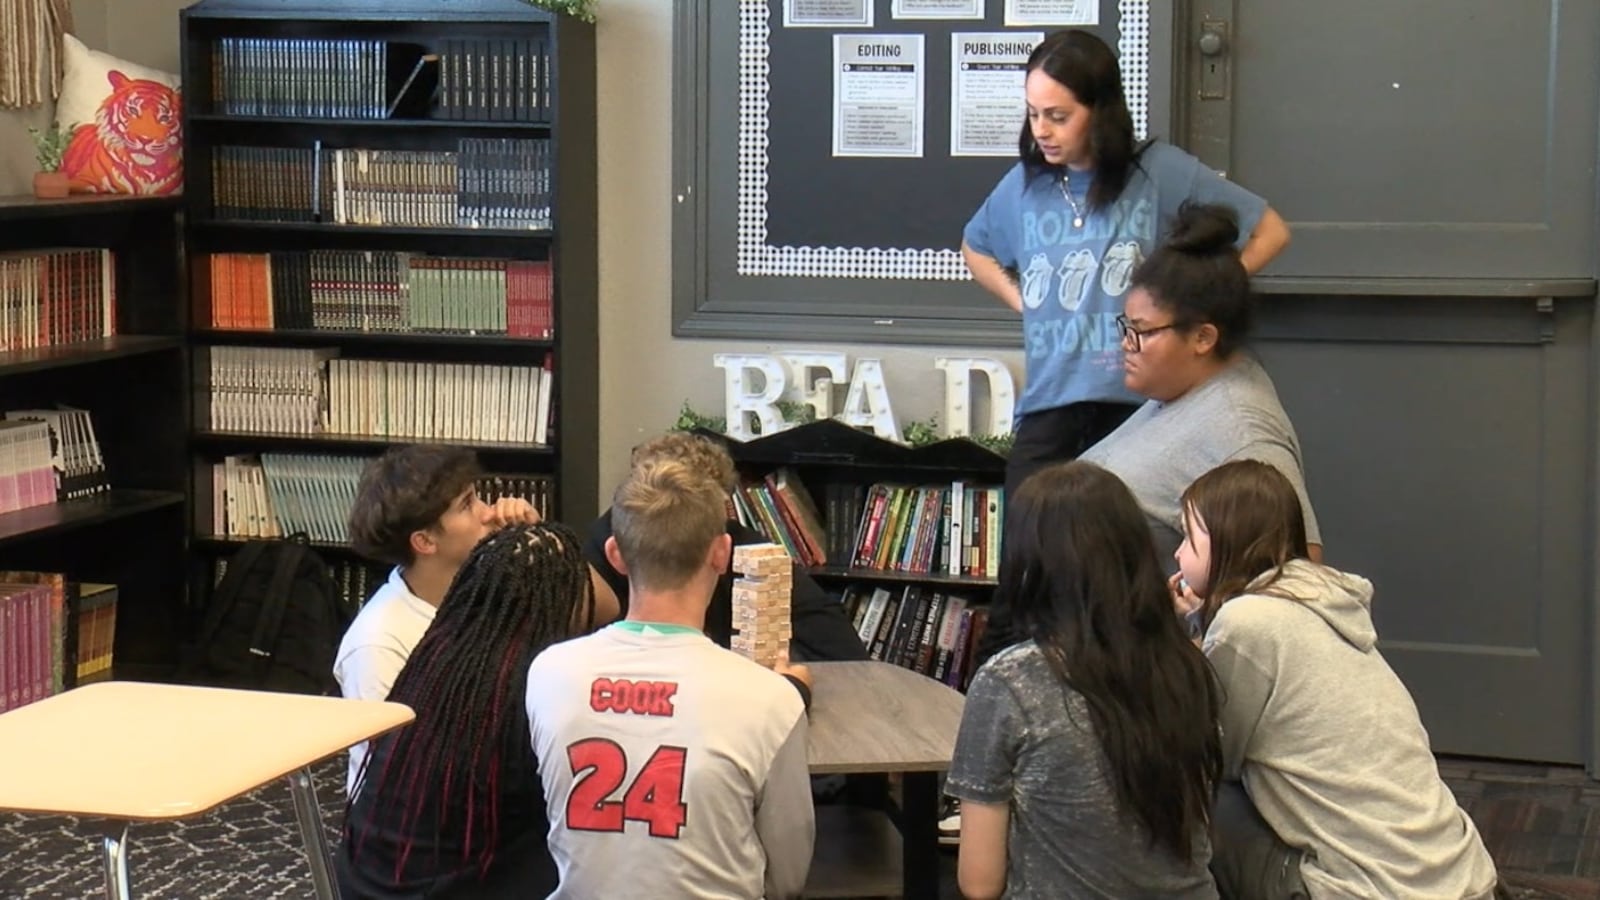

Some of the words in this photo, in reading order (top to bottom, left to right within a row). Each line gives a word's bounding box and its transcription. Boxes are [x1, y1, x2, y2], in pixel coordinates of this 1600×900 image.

[858, 44, 901, 57] EDITING
[963, 42, 1033, 56] PUBLISHING
[1028, 312, 1118, 358] STONE
[713, 352, 1016, 445] READ
[590, 677, 678, 717] COOK
[566, 738, 688, 839] 24
